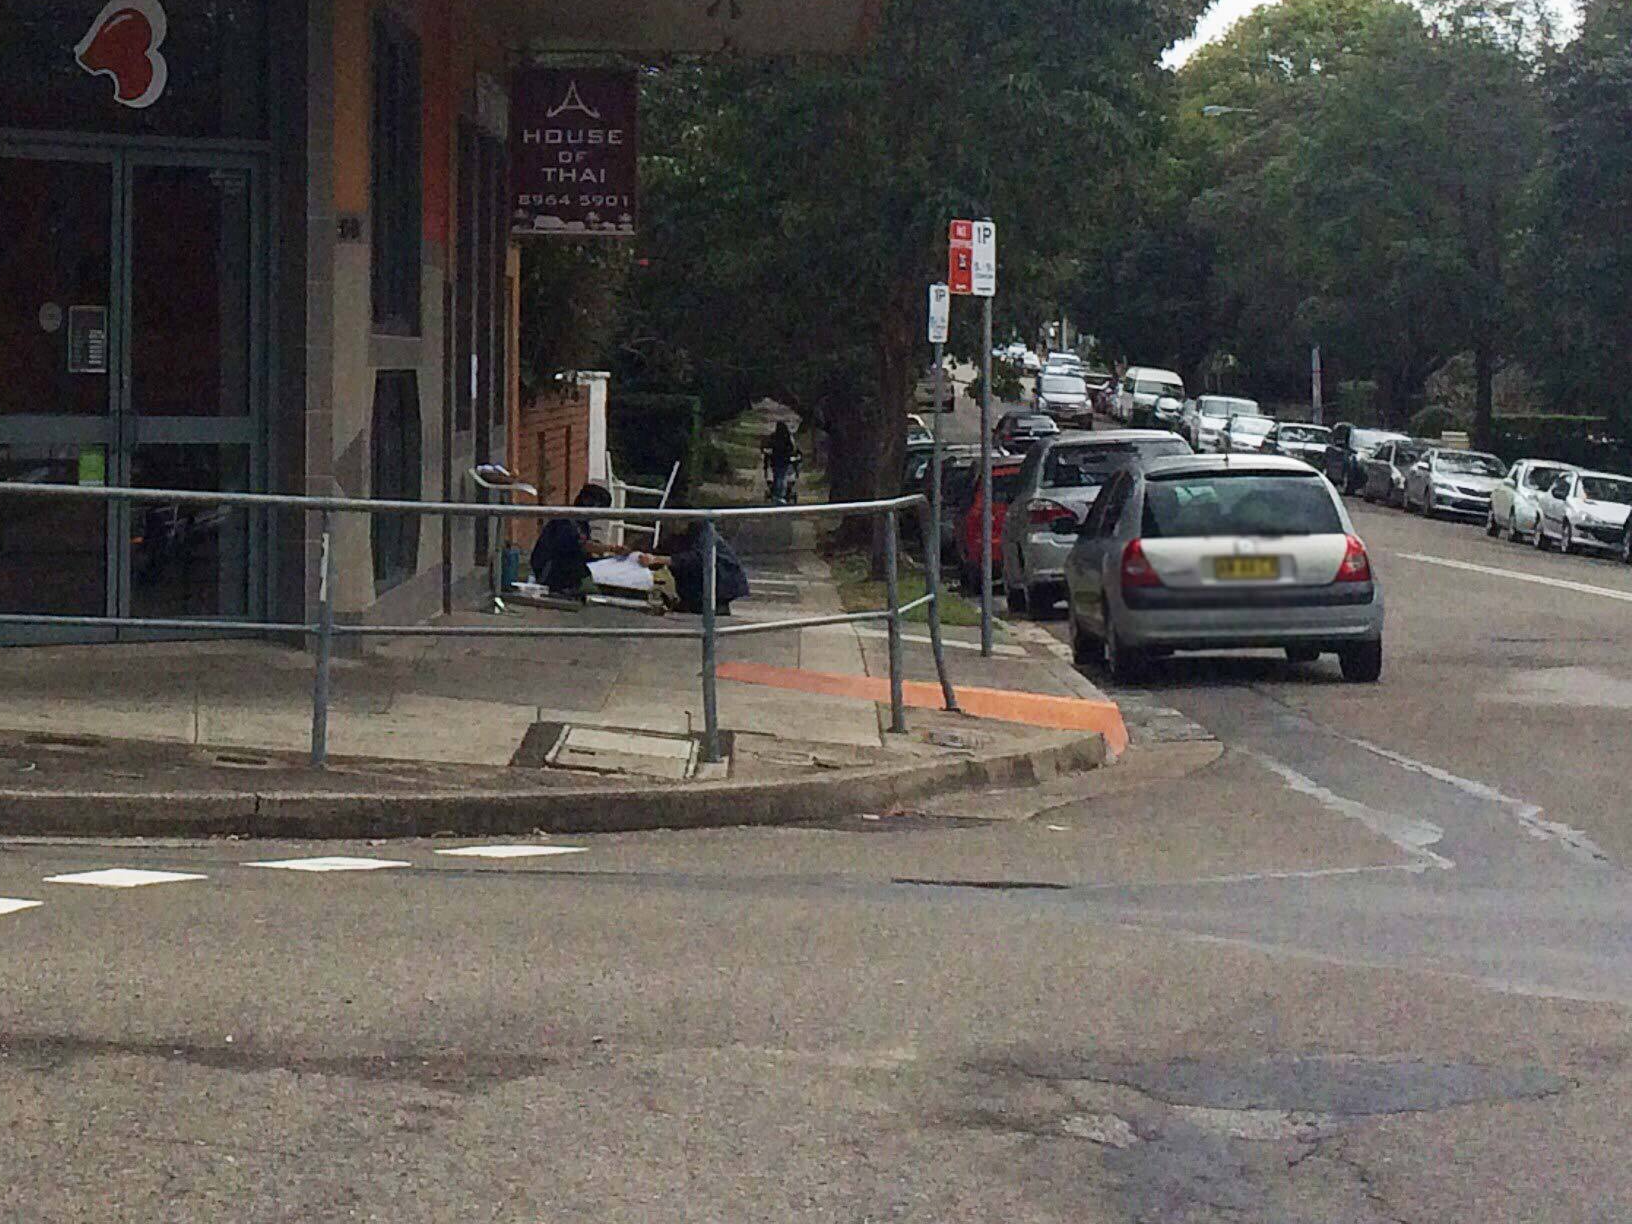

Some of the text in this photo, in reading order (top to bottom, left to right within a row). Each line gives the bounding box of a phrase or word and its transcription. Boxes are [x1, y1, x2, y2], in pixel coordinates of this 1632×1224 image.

[522, 129, 624, 145] HOUSE
[557, 150, 588, 164] OF
[541, 166, 607, 184] THAI
